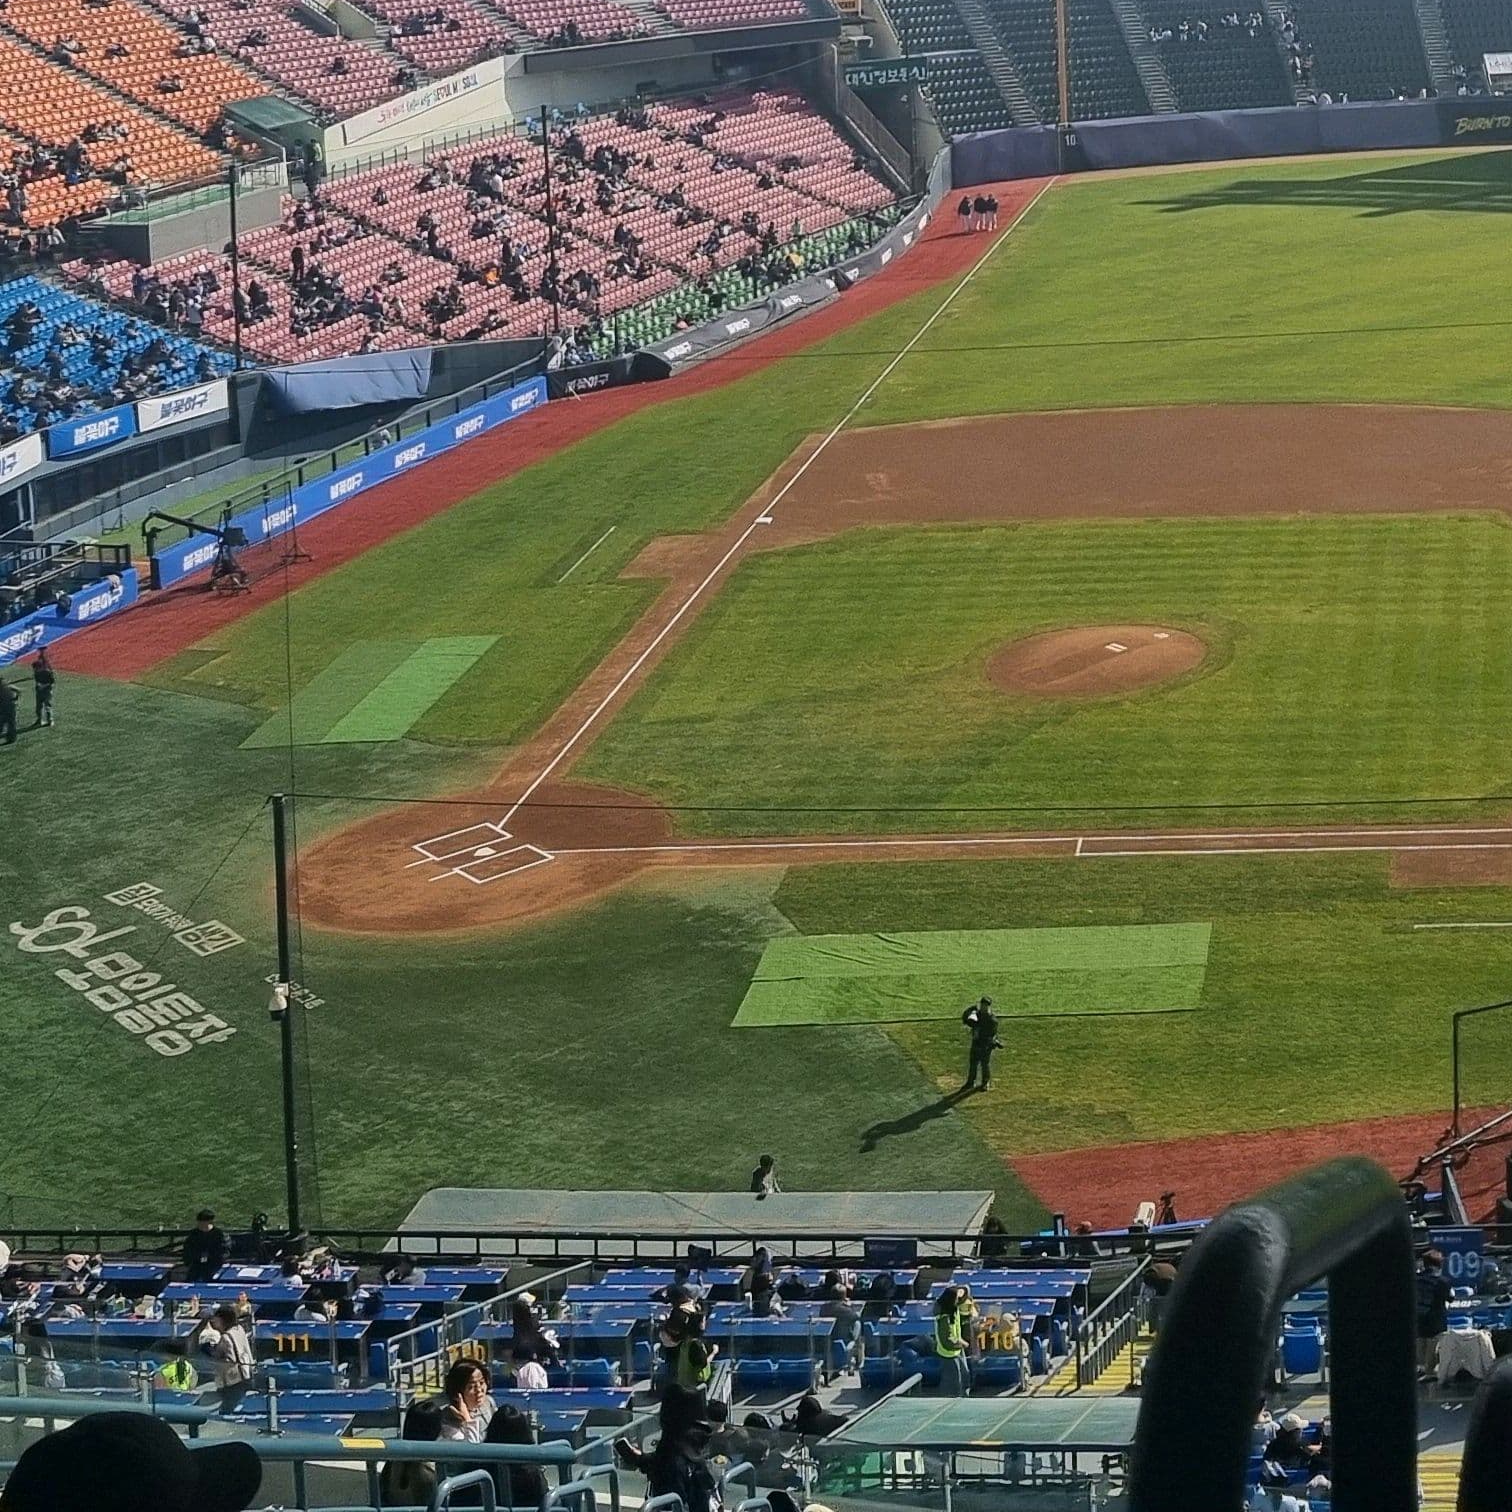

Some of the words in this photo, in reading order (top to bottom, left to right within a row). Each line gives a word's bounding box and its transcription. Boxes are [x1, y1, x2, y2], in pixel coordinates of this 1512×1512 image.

[845, 66, 927, 87] 대신정보통신
[1454, 114, 1494, 136] BURN
[160, 392, 208, 419] 불꽃야구
[74, 416, 120, 446] 불꽃야구
[78, 585, 123, 621] 불꽃야구
[275, 1332, 310, 1353] 111
[976, 1331, 1014, 1351] 110
